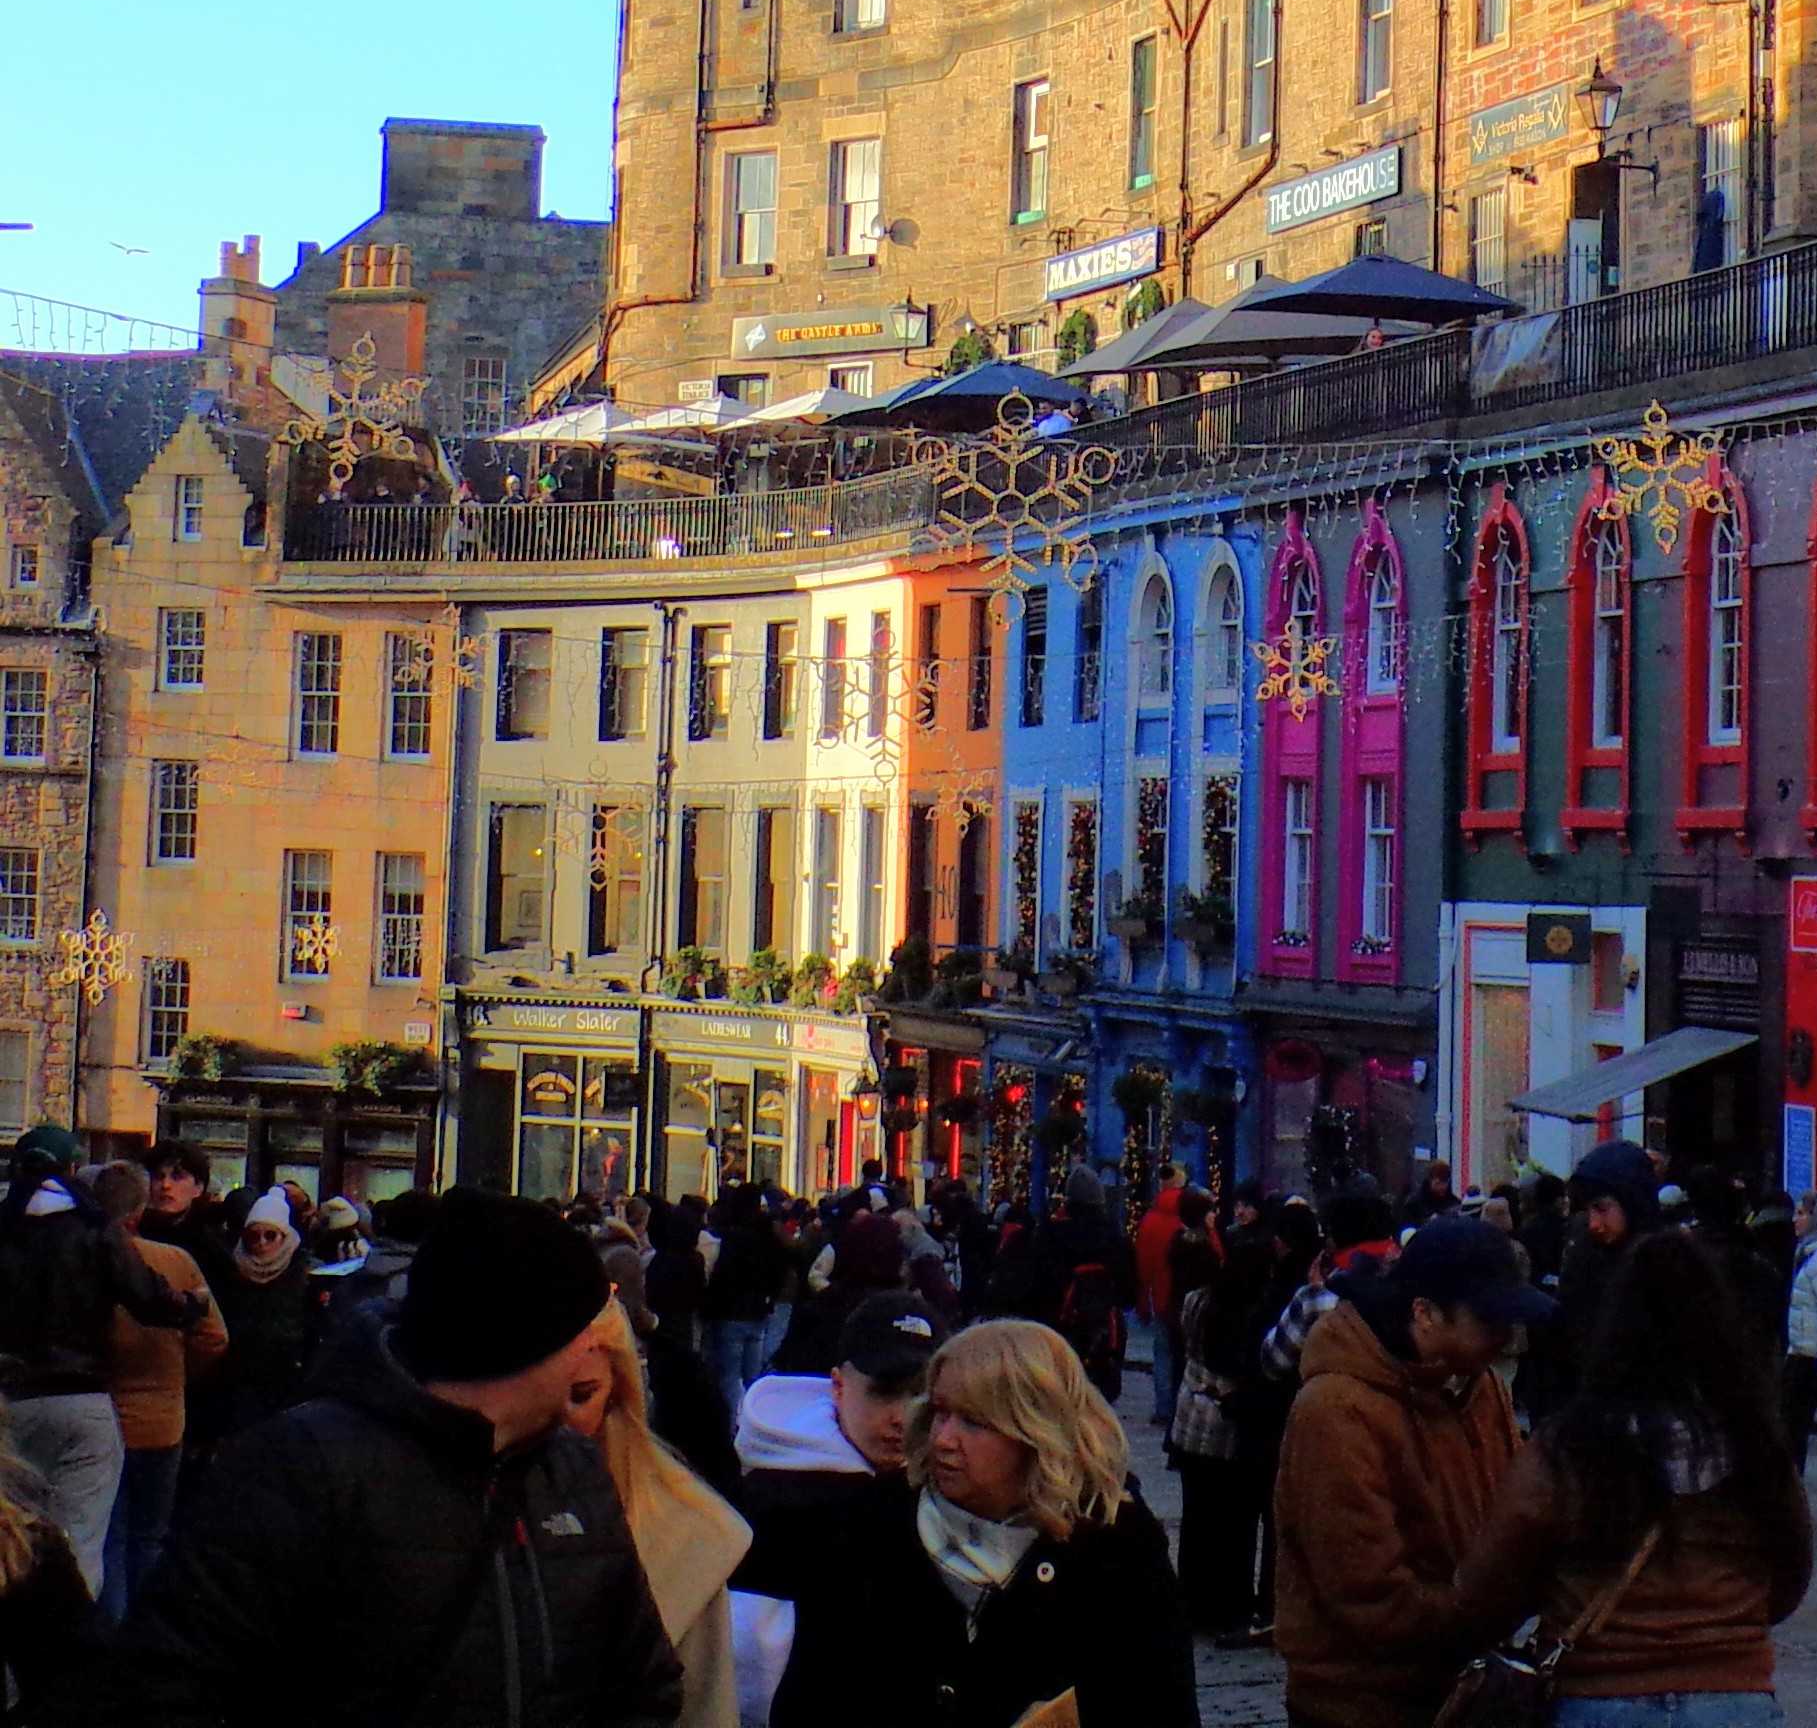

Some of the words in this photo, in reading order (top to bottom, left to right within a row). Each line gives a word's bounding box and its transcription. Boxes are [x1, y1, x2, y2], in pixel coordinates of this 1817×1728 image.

[1269, 190, 1292, 225] THE
[1293, 180, 1320, 217] COO
[1322, 154, 1395, 208] BAKEHOUSE
[1048, 239, 1132, 292] MAXIES
[775, 328, 797, 343] THE
[800, 325, 841, 341] CASTLE
[513, 1008, 567, 1029] Walker
[575, 1010, 622, 1032] Slater
